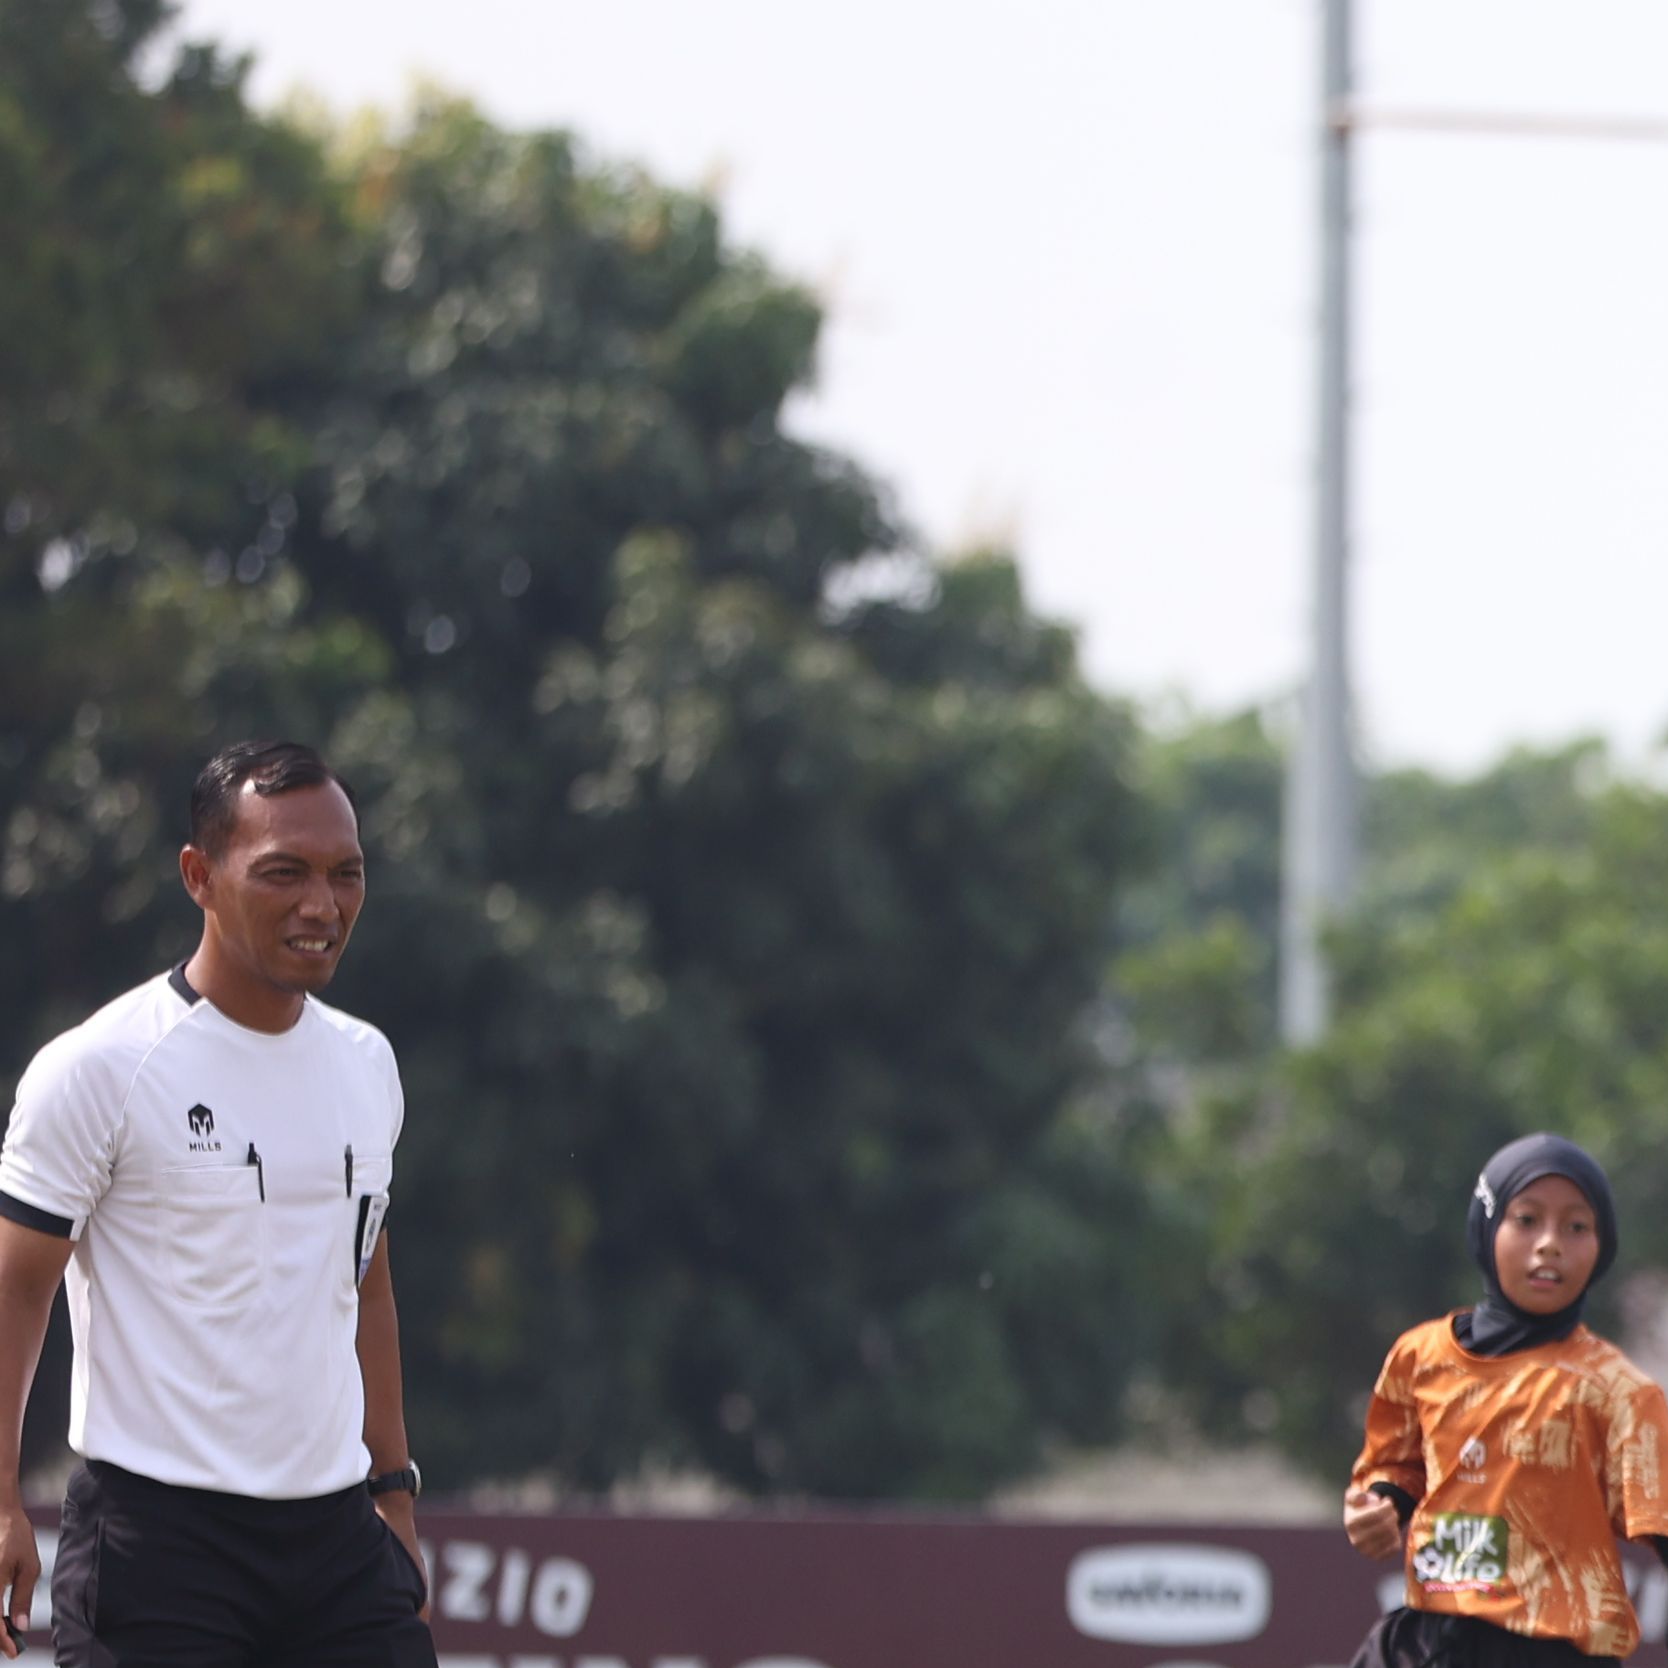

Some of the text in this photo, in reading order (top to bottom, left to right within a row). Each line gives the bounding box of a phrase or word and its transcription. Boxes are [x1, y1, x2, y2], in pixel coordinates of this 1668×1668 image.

[188, 1141, 222, 1153] MILLS
[1434, 1518, 1499, 1557] Milk
[1440, 1551, 1501, 1585] Life
